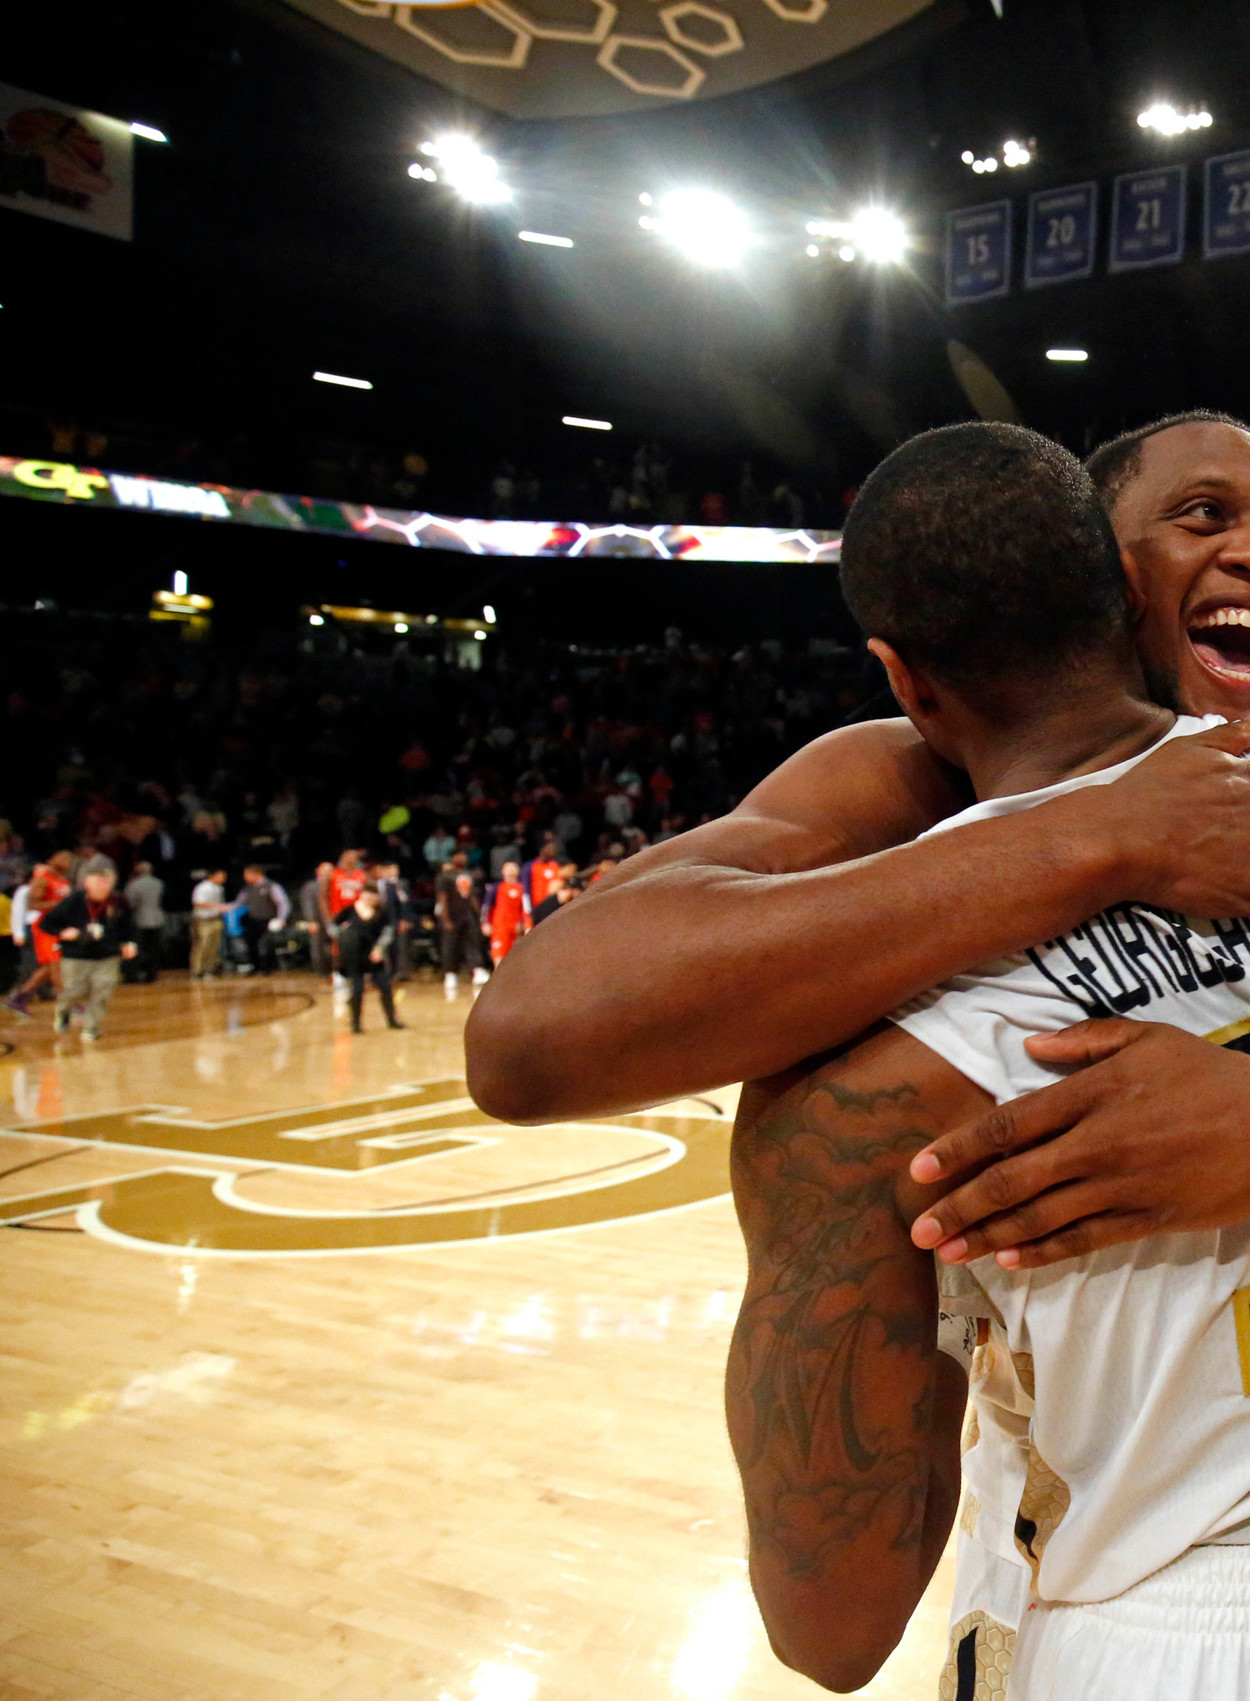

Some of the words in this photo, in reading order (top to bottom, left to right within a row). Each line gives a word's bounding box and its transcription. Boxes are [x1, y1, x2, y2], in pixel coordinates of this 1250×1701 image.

[1136, 199, 1161, 231] 21
[1046, 215, 1076, 248] 20
[967, 234, 989, 265] 15
